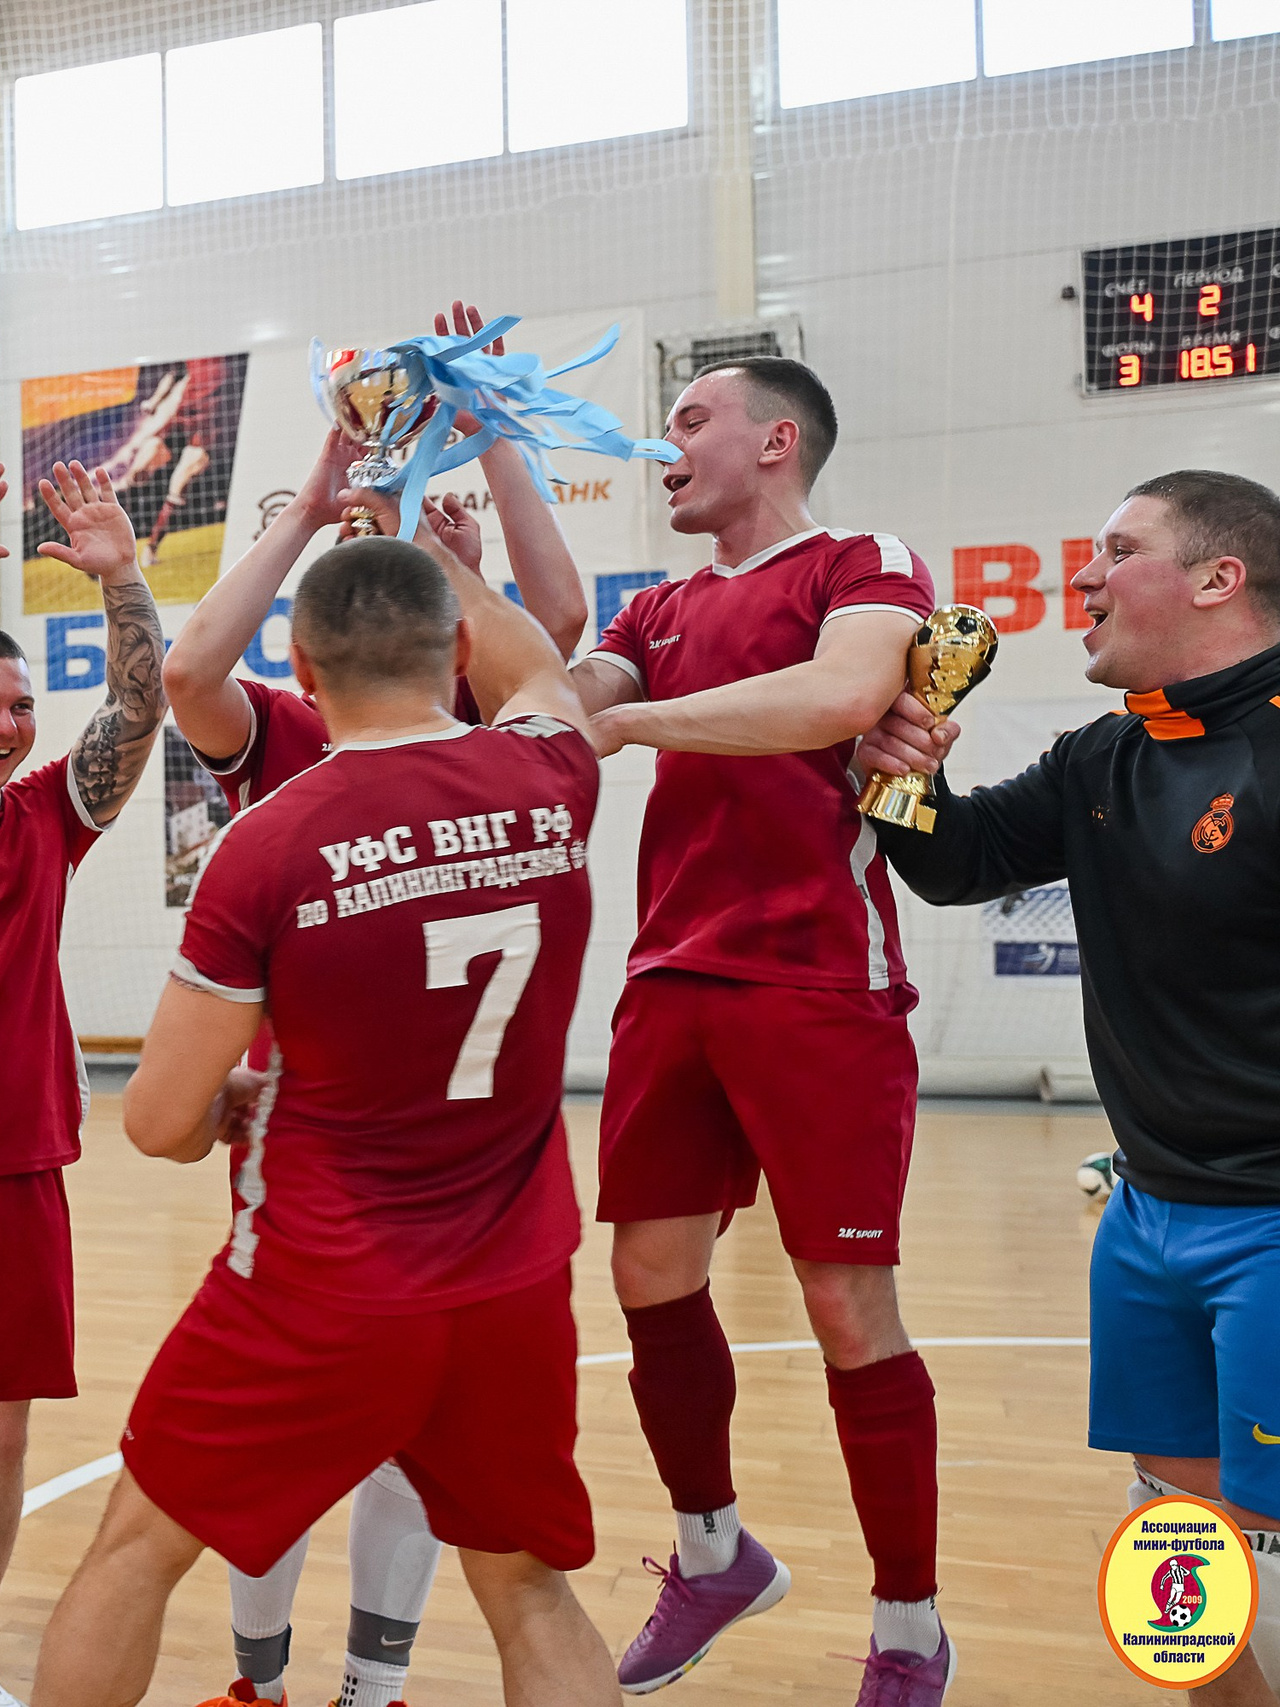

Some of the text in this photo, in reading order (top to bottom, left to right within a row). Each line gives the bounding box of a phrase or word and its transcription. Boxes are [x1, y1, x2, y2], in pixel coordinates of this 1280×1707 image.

[1130, 292, 1154, 322] 4
[1199, 284, 1221, 316] 2
[1119, 354, 1140, 386] 3
[319, 825, 417, 883] УФС
[427, 810, 517, 857] ВНГ
[529, 804, 573, 843] РФ
[422, 902, 542, 1100] 7
[838, 1228, 856, 1238] 2K
